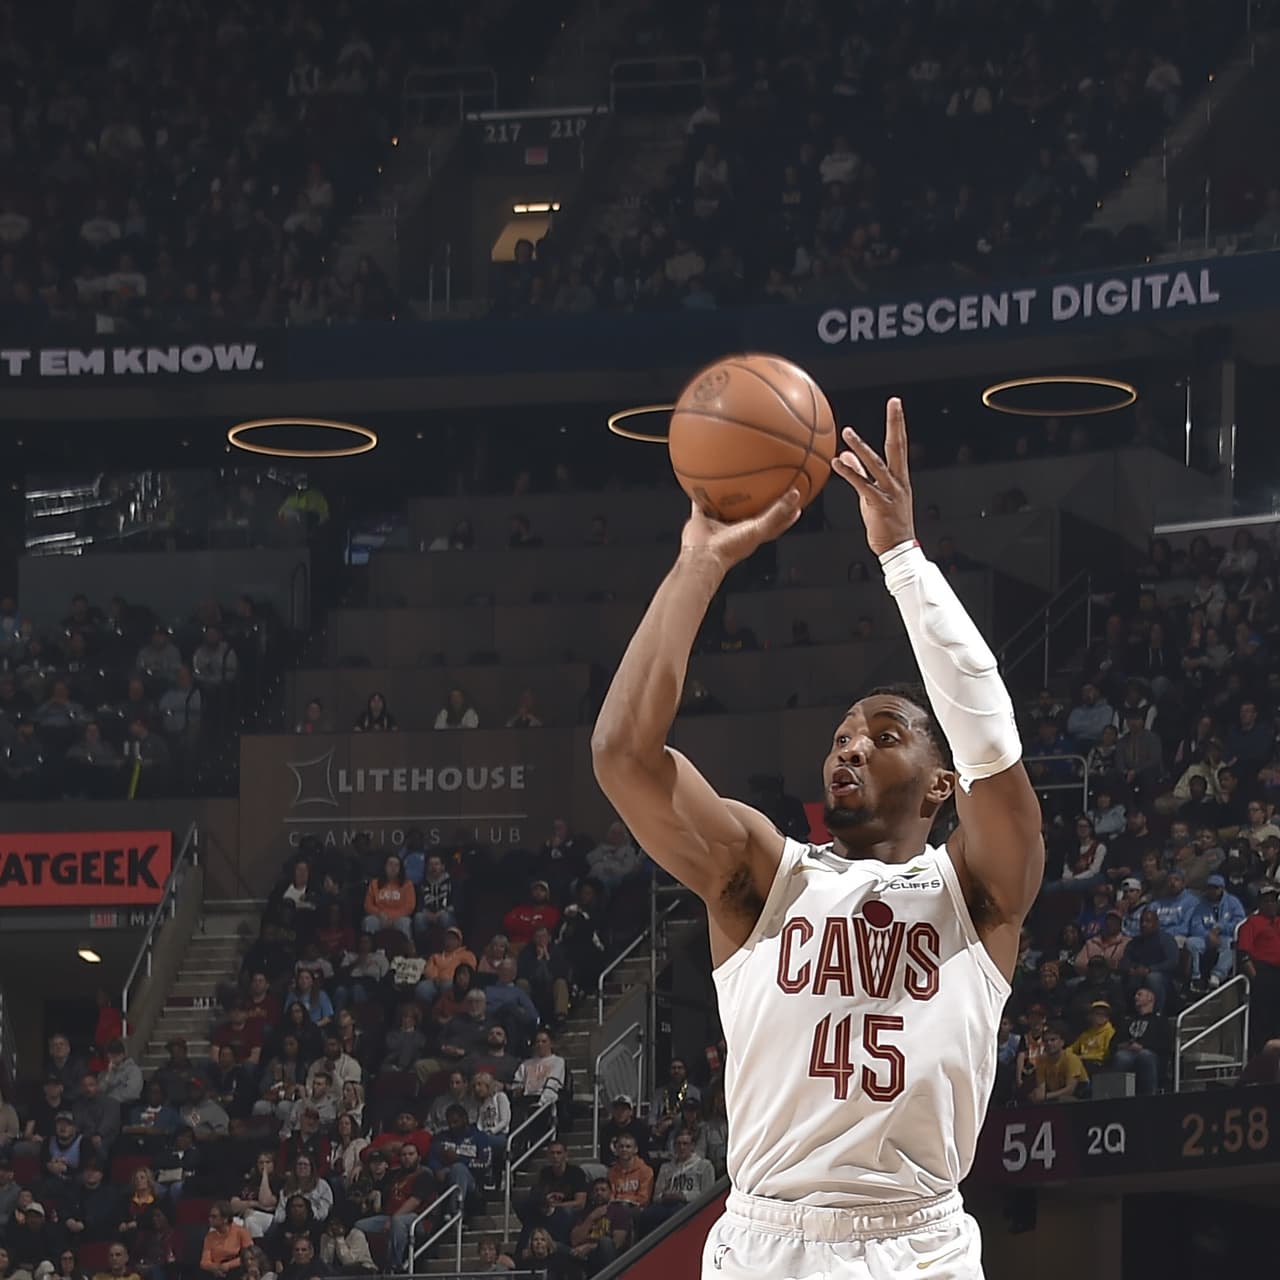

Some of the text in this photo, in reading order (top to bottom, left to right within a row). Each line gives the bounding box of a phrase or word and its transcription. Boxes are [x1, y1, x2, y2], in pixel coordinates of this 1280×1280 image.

[818, 270, 1221, 344] CRESCENT DIGITAL
[39, 349, 105, 375] EM
[113, 344, 264, 375] KNOW.
[338, 765, 526, 792] LITEHOUSE
[890, 879, 941, 890] CLIFFS
[776, 916, 941, 1001] CAVS
[808, 1012, 906, 1102] 45
[1001, 1121, 1057, 1172] 54
[1087, 1123, 1126, 1156] 2Q
[1181, 1106, 1270, 1156] 2:58
